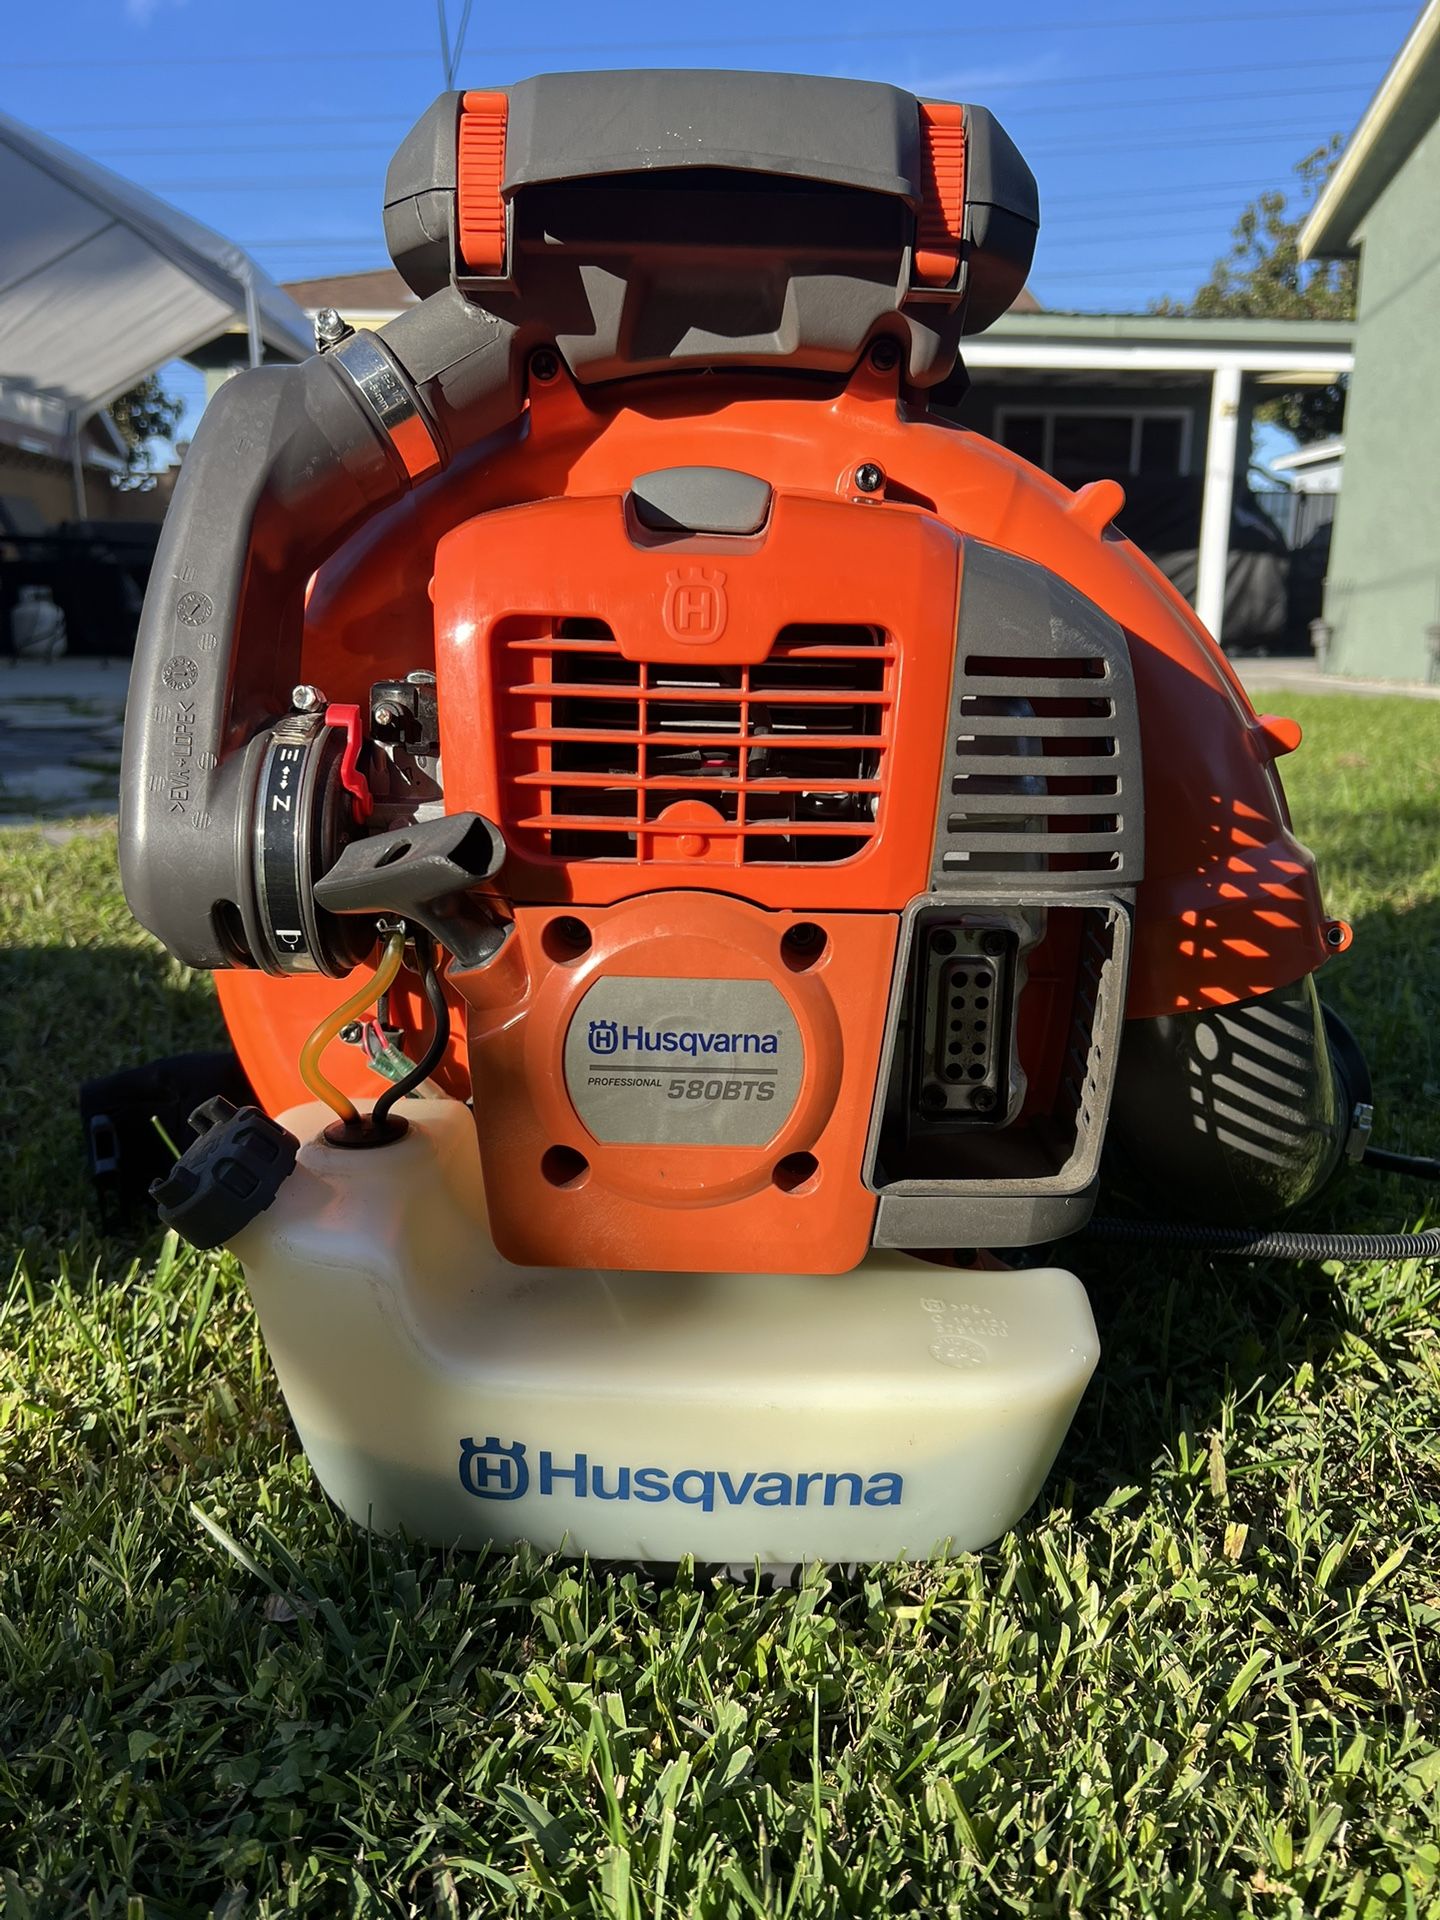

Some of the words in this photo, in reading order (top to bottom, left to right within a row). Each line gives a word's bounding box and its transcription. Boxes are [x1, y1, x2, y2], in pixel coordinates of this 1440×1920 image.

[622, 1025, 778, 1056] Husqvarna
[587, 1077, 662, 1087] PROFESSIONAL
[667, 1079, 776, 1102] 580BTS
[539, 1451, 904, 1512] Husqvarna
